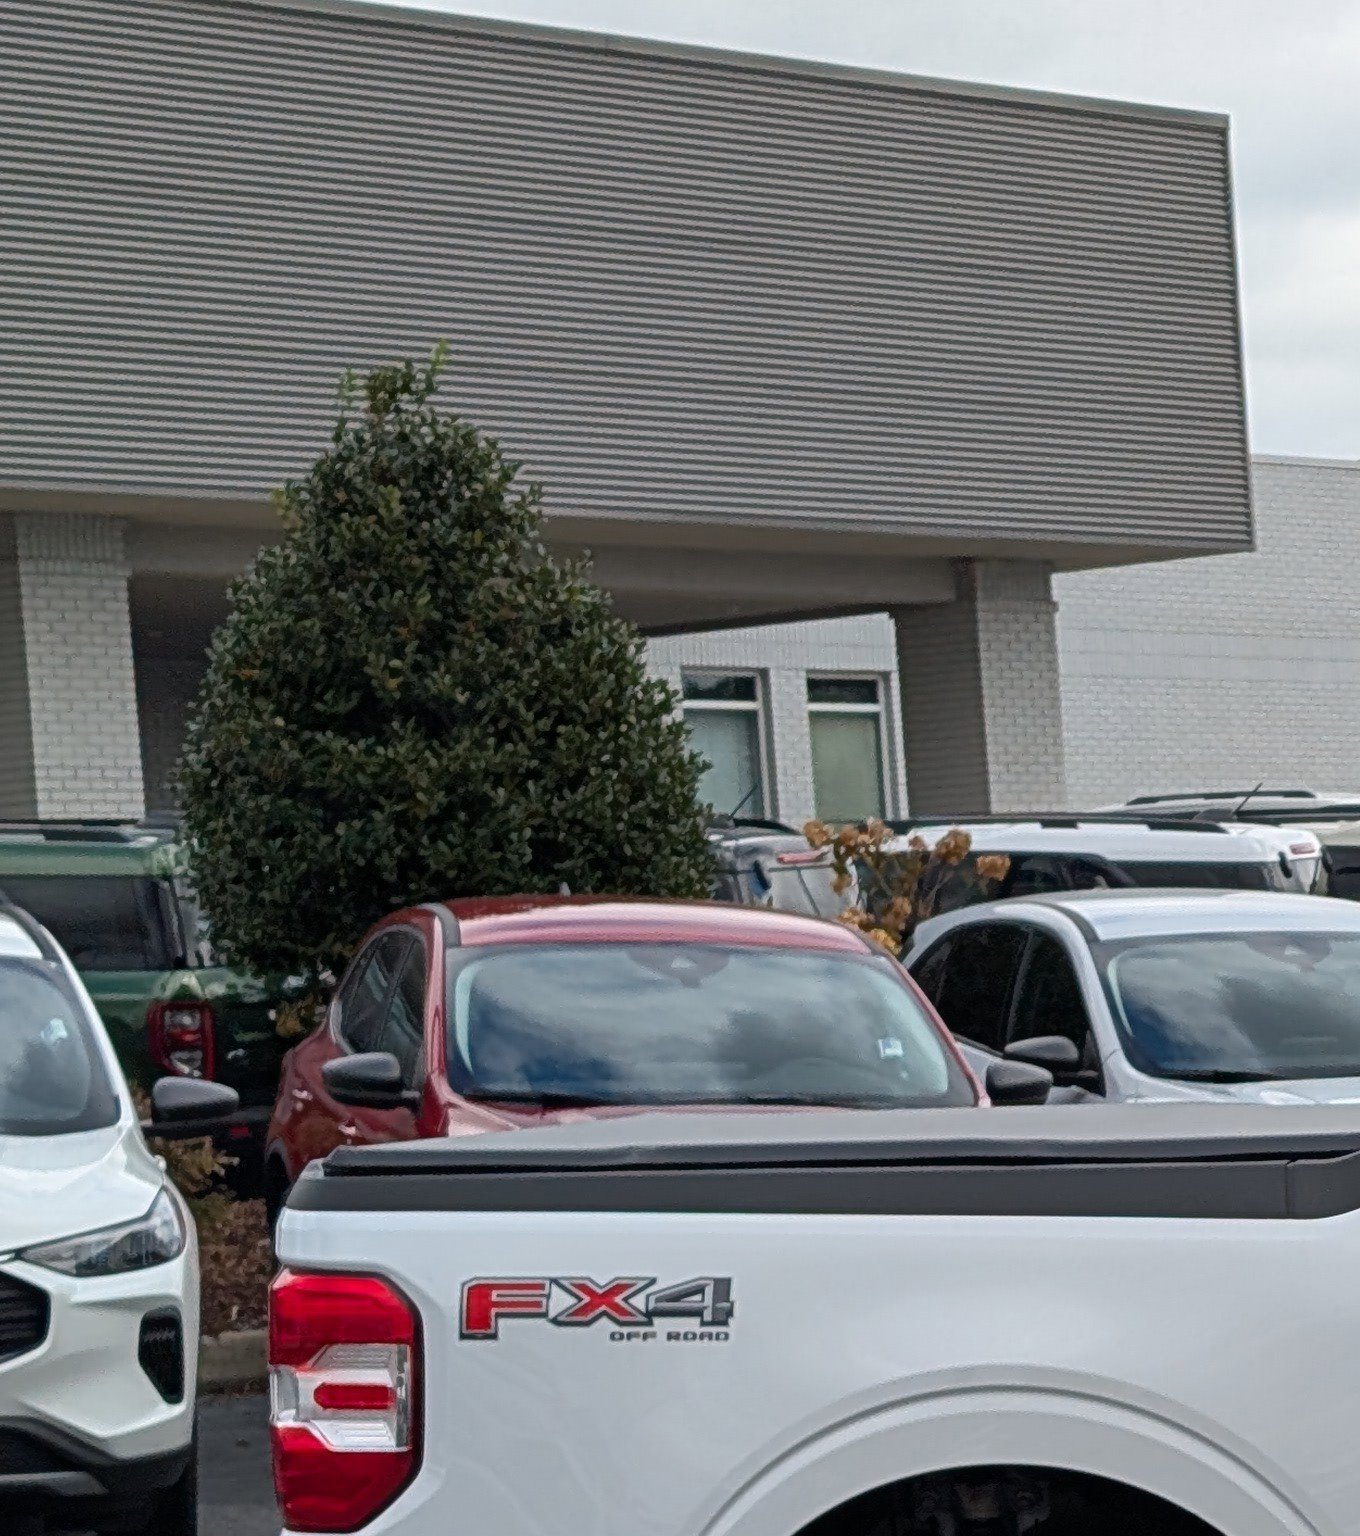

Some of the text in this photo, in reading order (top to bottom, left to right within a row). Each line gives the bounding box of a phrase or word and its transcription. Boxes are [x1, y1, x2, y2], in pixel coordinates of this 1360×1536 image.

[459, 1277, 734, 1340] FX4
[610, 1331, 729, 1342] OFF ROAD
